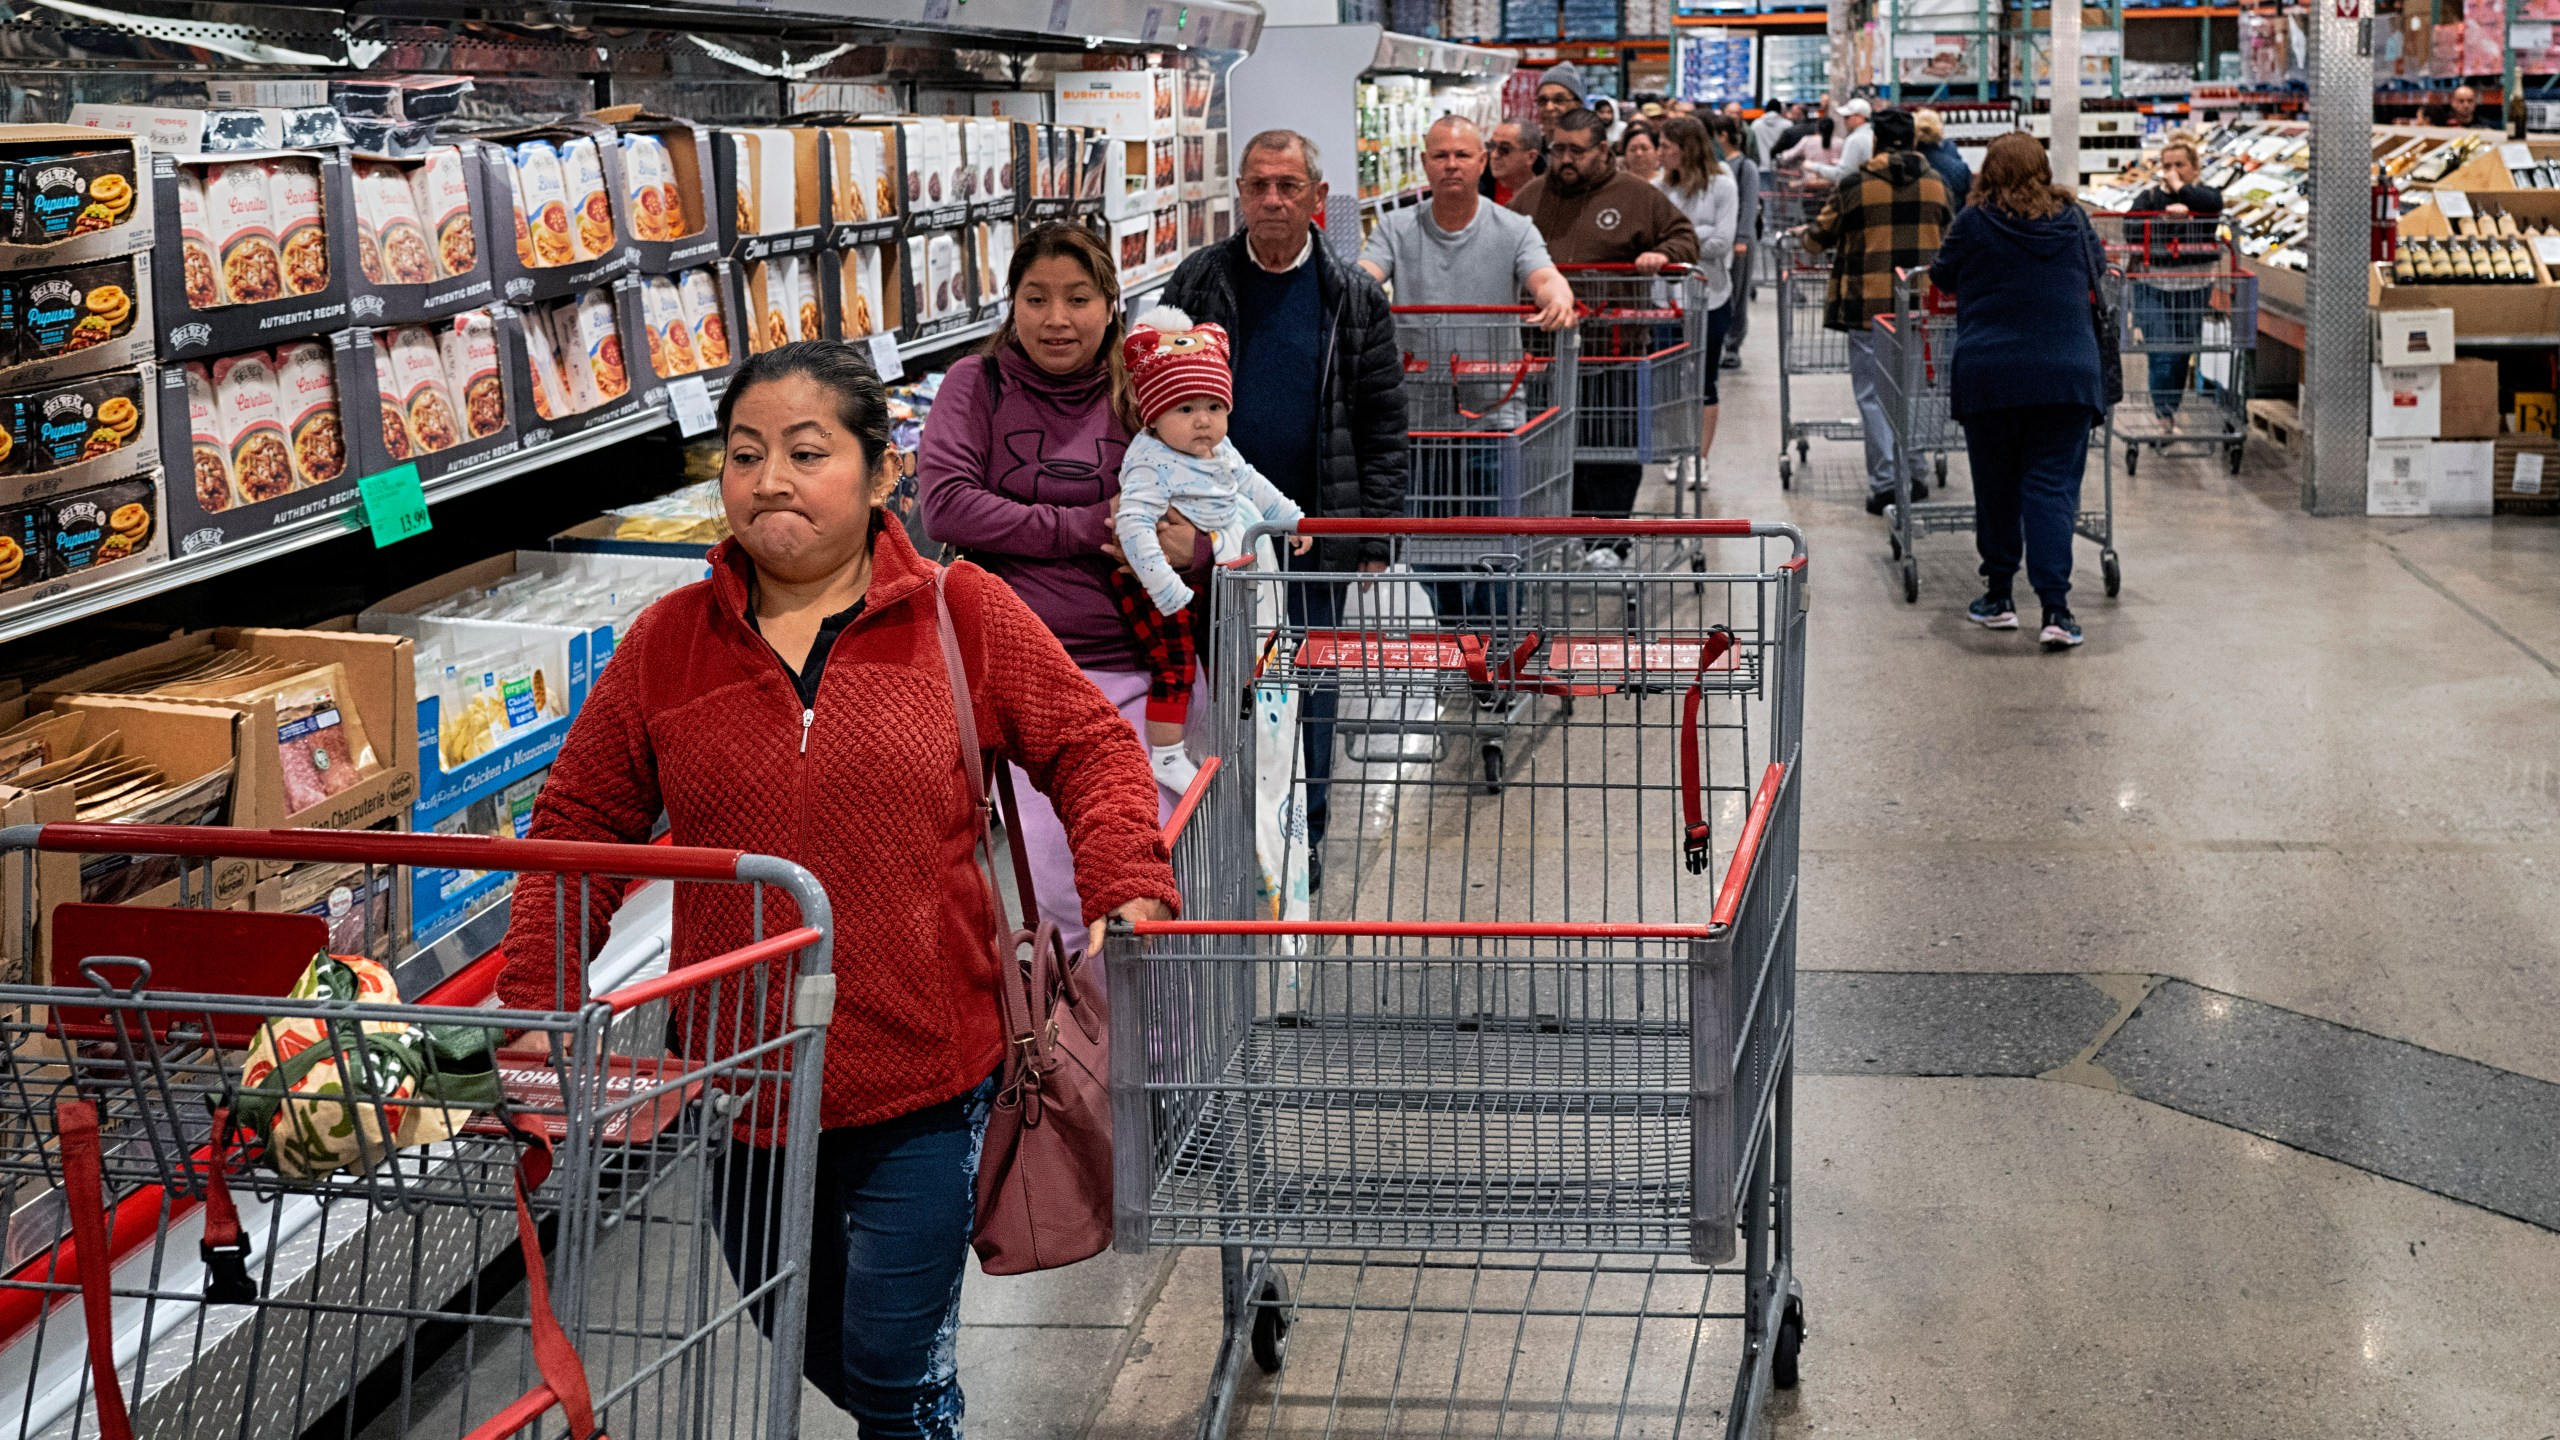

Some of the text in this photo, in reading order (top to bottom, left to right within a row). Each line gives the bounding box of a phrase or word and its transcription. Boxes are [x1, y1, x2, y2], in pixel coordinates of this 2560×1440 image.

[1063, 91, 1141, 100] BURNT ENDS
[155, 166, 174, 174] REAL
[34, 194, 80, 214] Pupusas
[138, 257, 148, 266] 10
[424, 280, 492, 309] AUTHENTIC RECIPE
[28, 308, 76, 327] Pupusas
[259, 304, 346, 330] AUTHENTIC RECIPE
[144, 366, 154, 374] 10
[166, 376, 182, 384] REAL
[42, 421, 88, 441] Pupusas
[448, 441, 519, 472] AUTHENTIC RECIPE
[273, 502, 328, 525] AUTHENTIC
[328, 487, 361, 506] RECIPE
[400, 508, 426, 533] 13.99
[56, 528, 102, 550] Pupusas
[462, 764, 502, 793] Chicken
[502, 756, 510, 772] &
[512, 733, 562, 768] Mozzarella
[332, 792, 386, 830] Charcuterie
